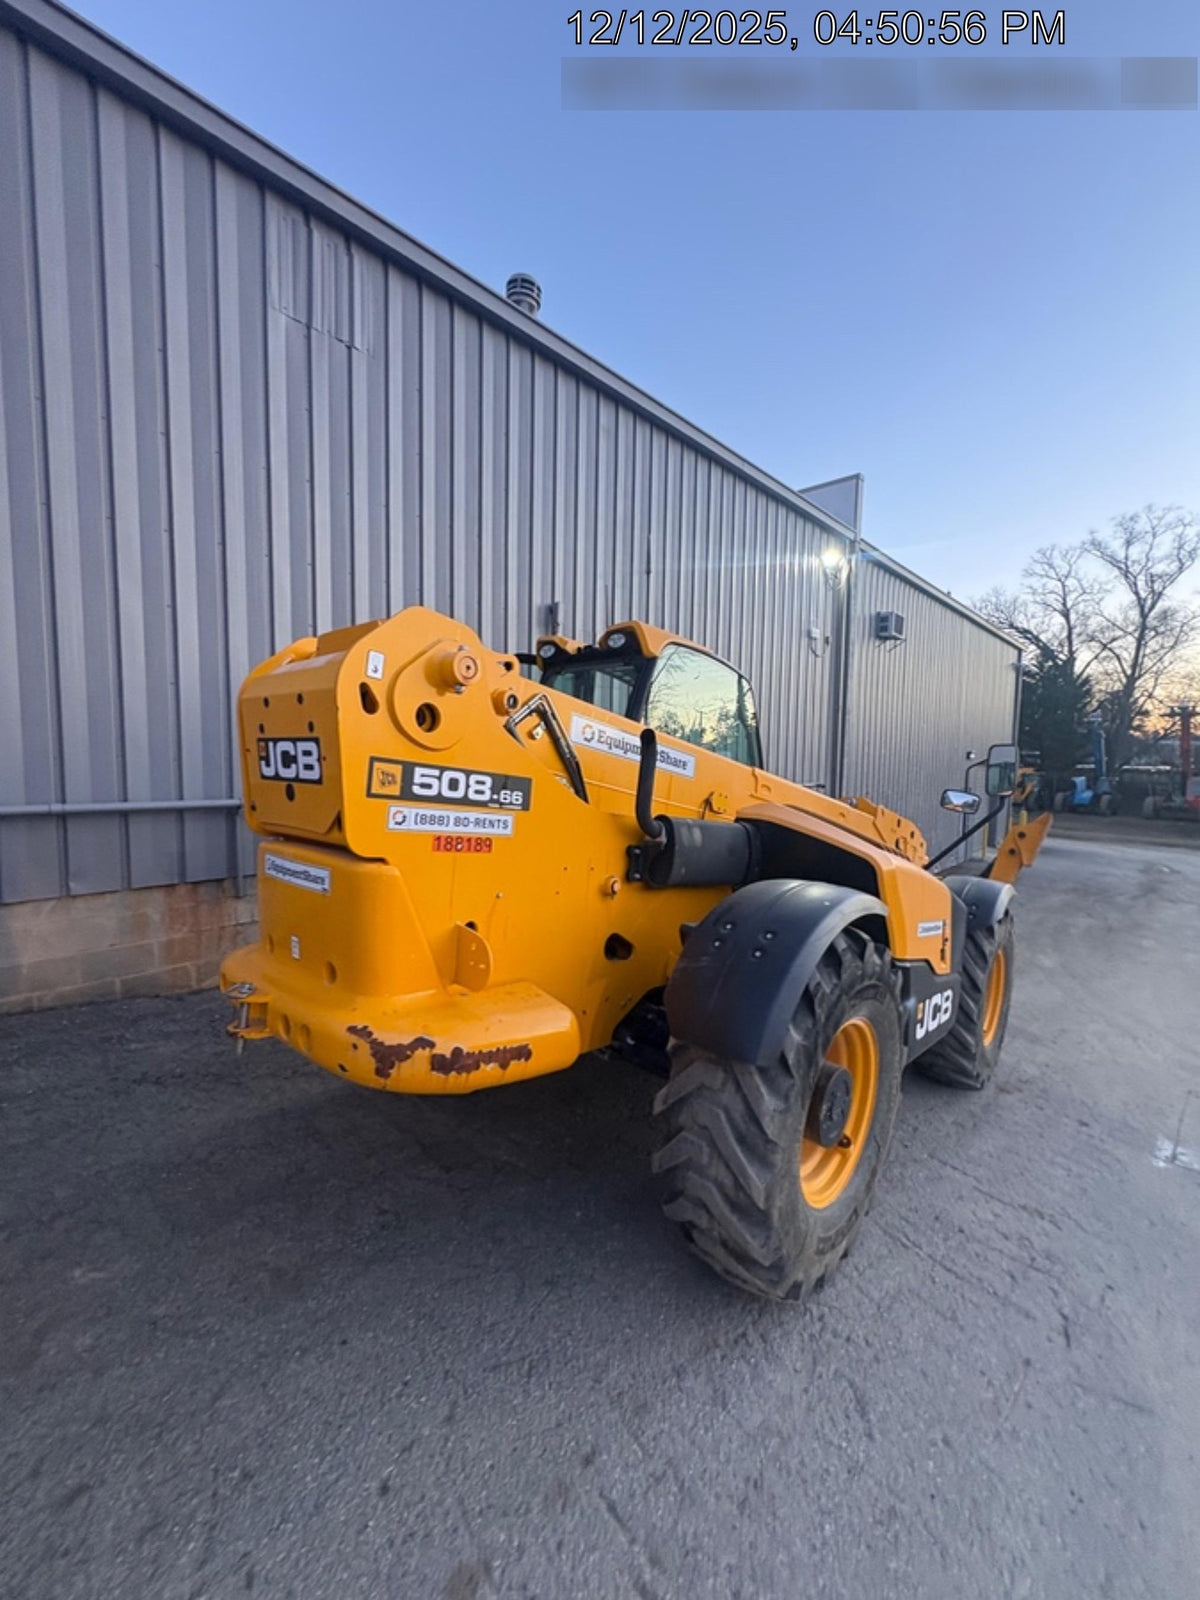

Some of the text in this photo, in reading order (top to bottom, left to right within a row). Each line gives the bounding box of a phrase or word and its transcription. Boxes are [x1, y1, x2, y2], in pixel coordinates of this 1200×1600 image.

[259, 740, 321, 781] JCB
[413, 812, 509, 830] (888) 80-RENTS
[433, 835, 492, 852] 188189
[915, 988, 953, 1040] JCB
